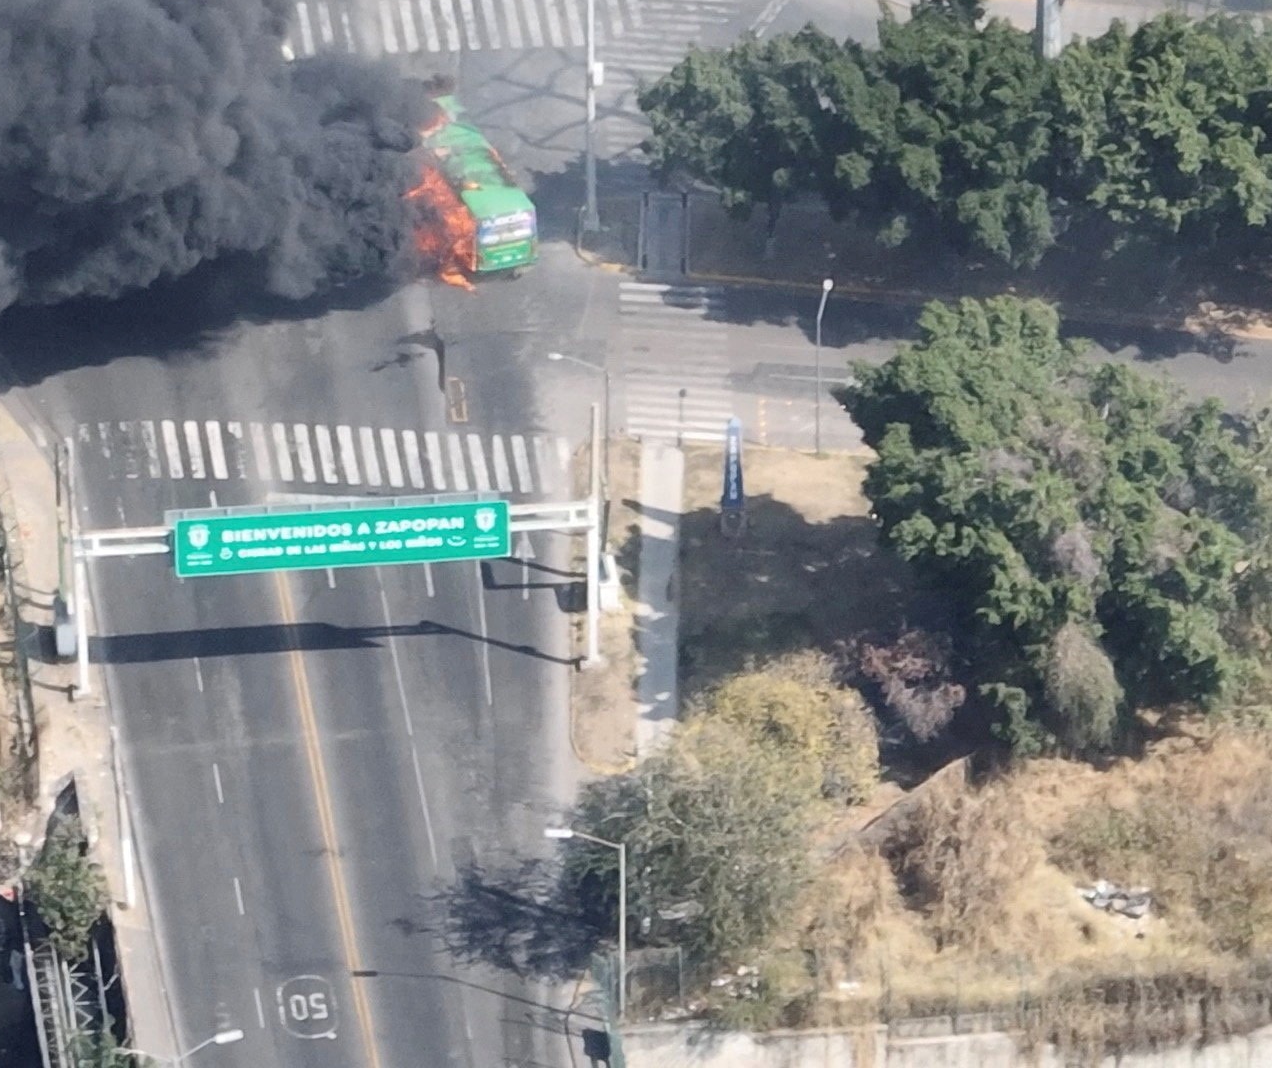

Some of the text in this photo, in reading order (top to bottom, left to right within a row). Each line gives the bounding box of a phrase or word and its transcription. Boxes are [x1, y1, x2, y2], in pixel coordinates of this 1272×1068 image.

[221, 516, 465, 544] BIENVENIDOS A ZAPOPAN
[289, 993, 329, 1021] 50
